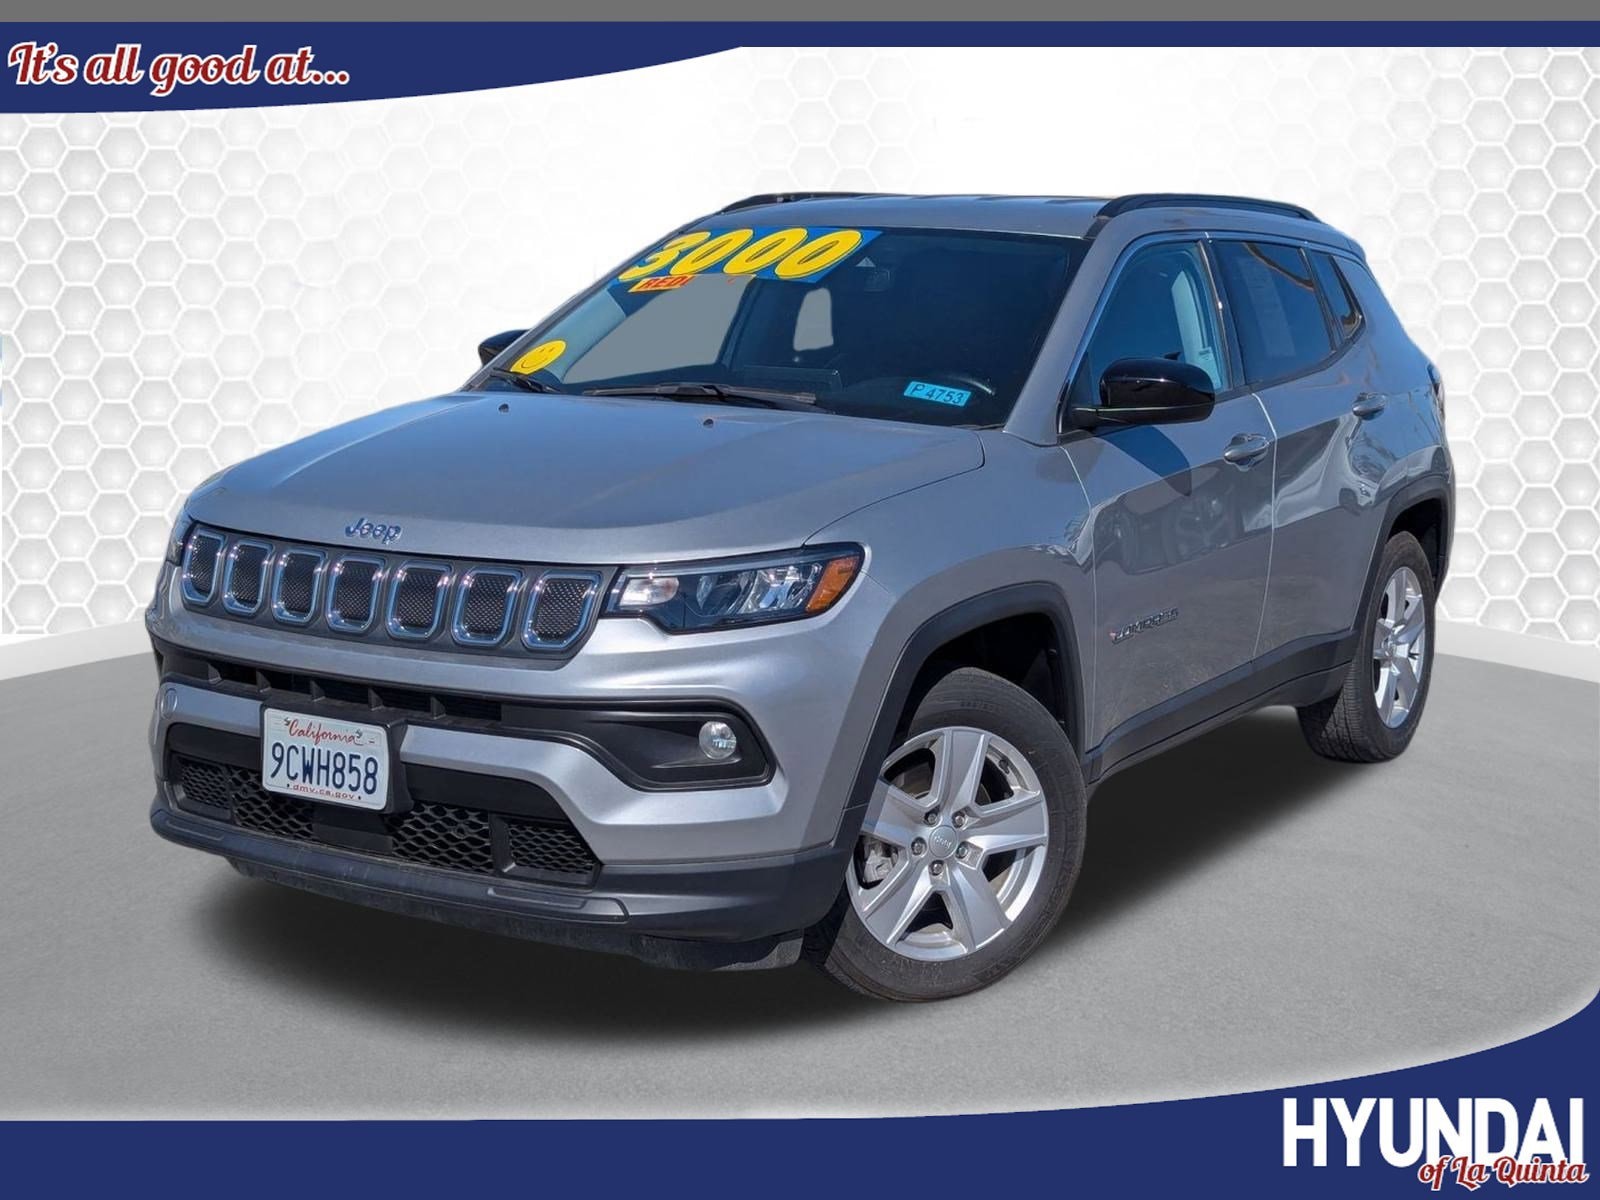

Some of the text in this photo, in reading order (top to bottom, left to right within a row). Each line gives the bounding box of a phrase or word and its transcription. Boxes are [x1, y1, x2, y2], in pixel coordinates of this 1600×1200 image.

[618, 227, 862, 281] 3000
[910, 383, 964, 404] P 4753
[345, 518, 402, 545] Jeep
[288, 718, 356, 745] California
[270, 742, 379, 795] 9CWH858
[292, 783, 355, 800] dmv.ca.gov
